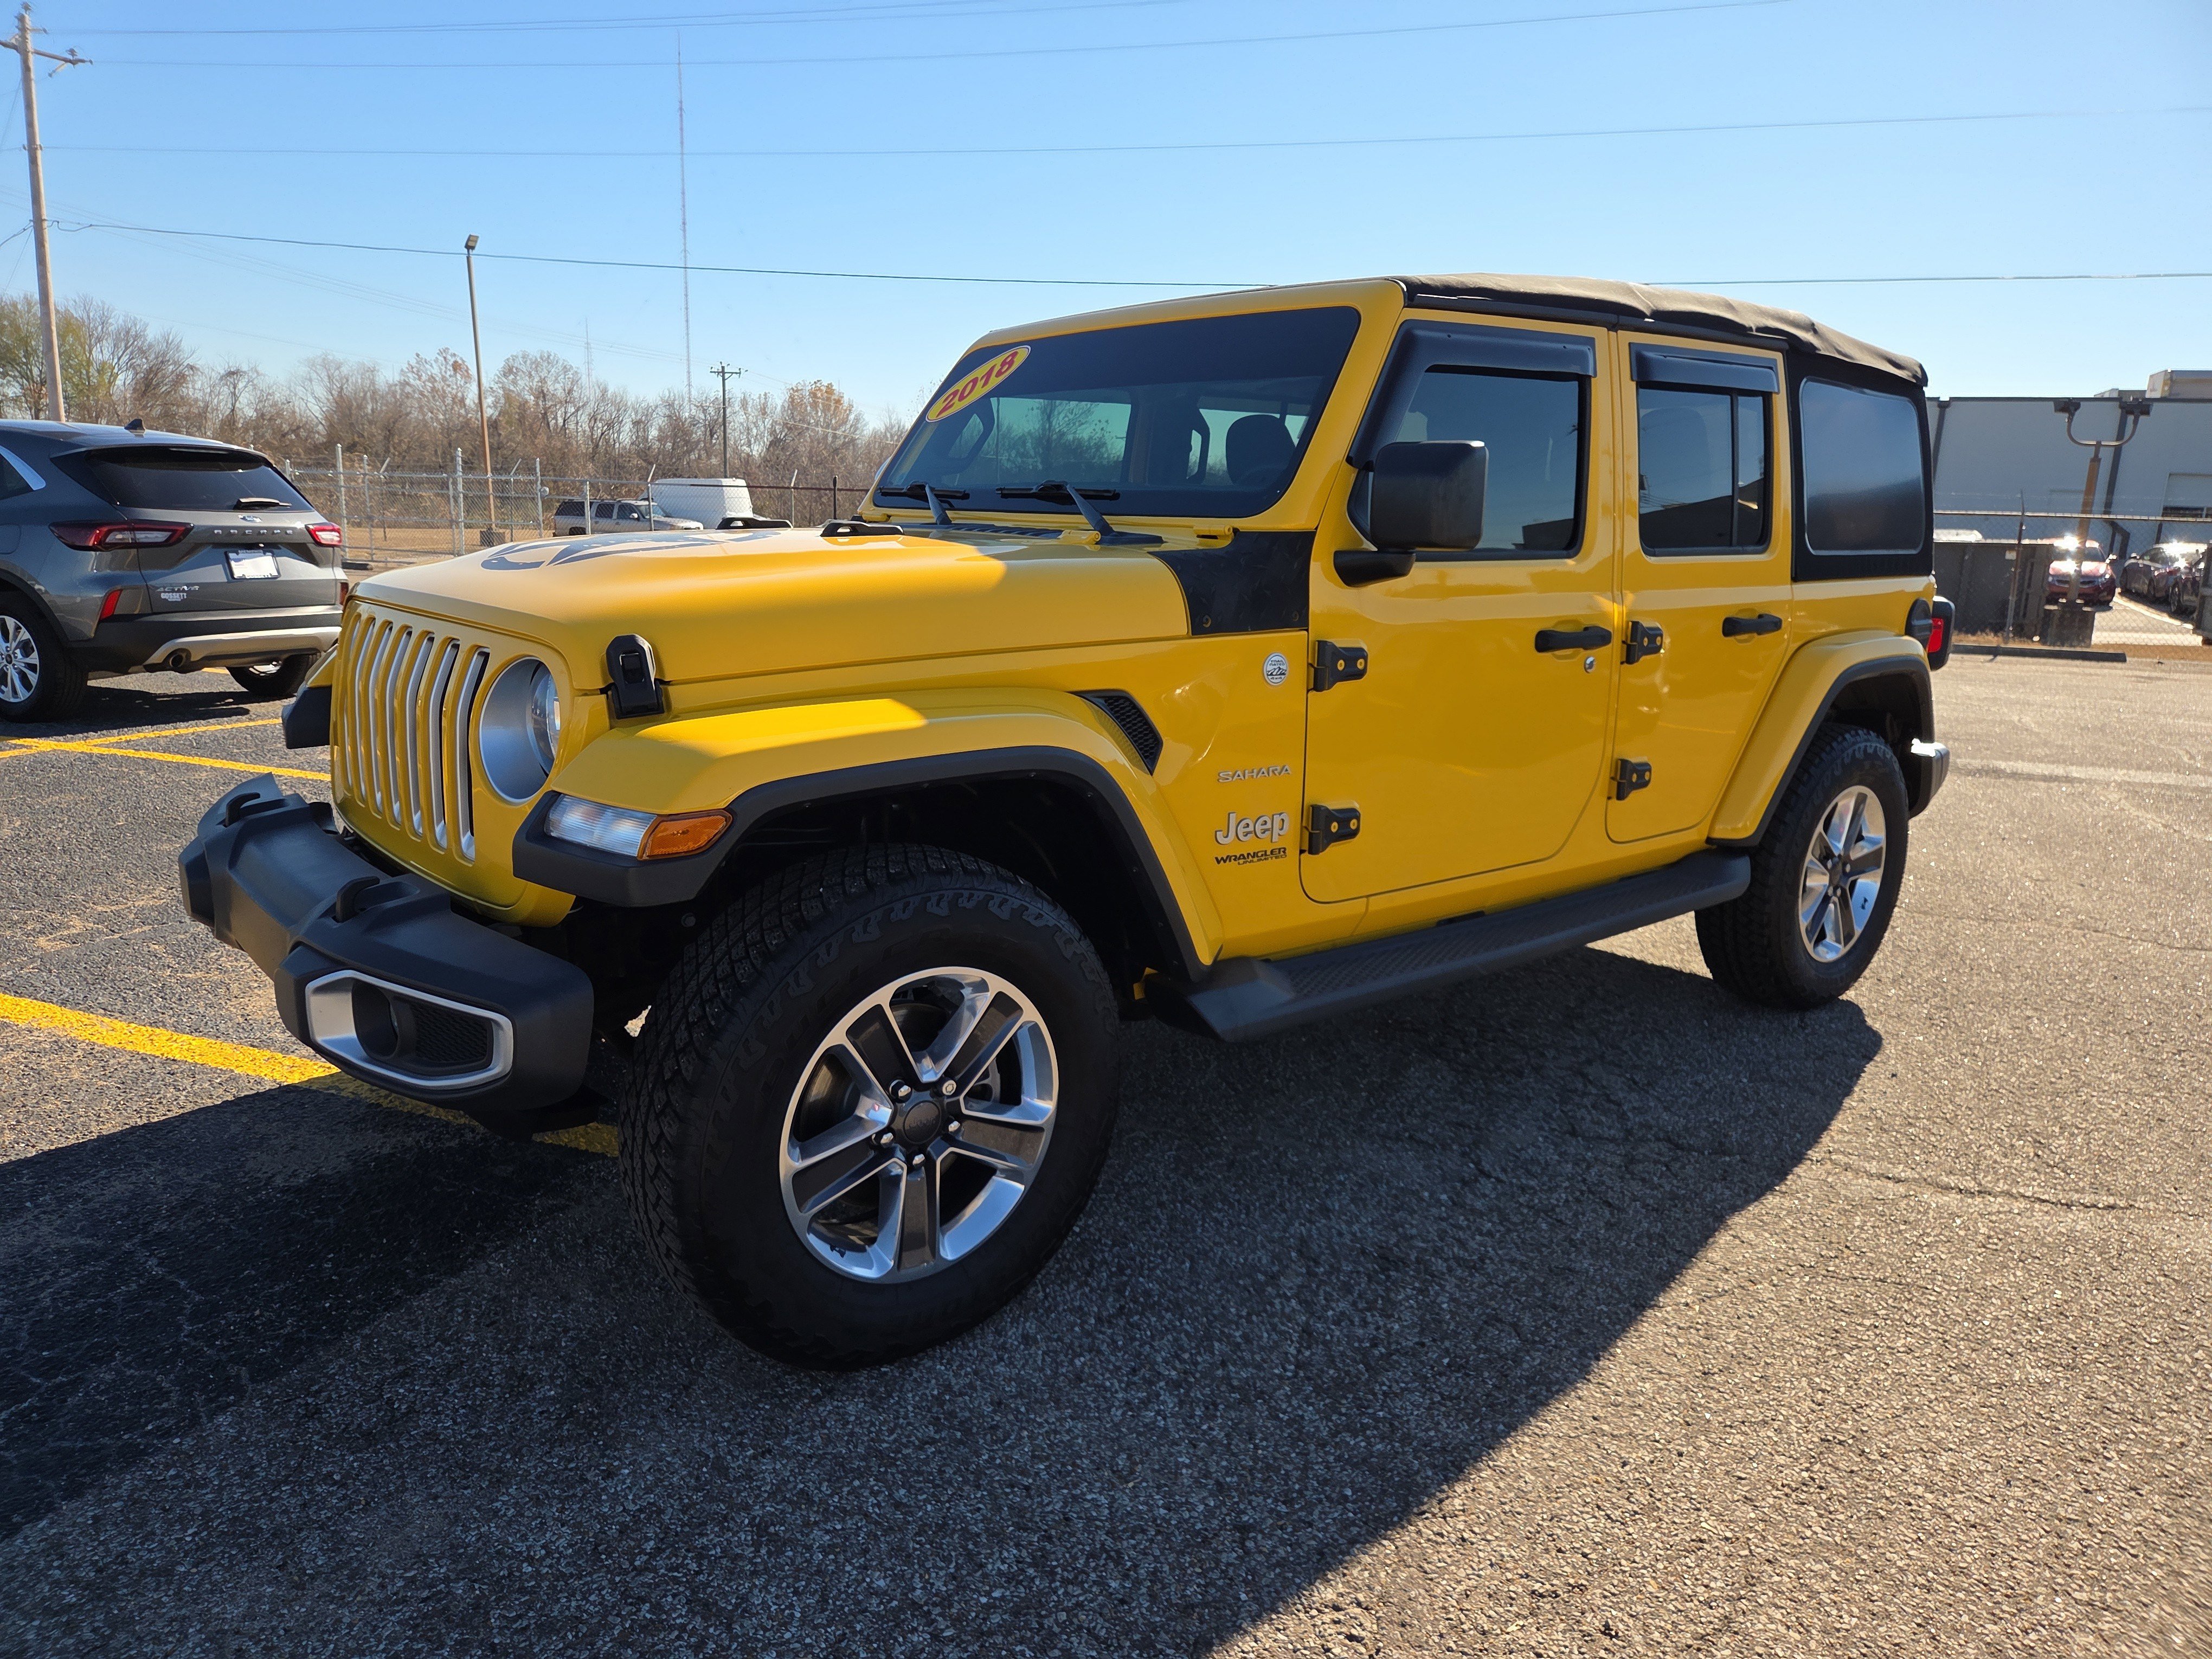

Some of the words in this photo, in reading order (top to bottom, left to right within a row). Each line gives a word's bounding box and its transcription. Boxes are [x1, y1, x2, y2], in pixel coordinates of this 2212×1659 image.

[936, 351, 1019, 418] 2018
[1218, 764, 1291, 782] SAHARA
[1215, 812, 1289, 845] Jeep
[1215, 847, 1287, 865] WRANGLER
[1238, 854, 1287, 865] UNLIMITED
